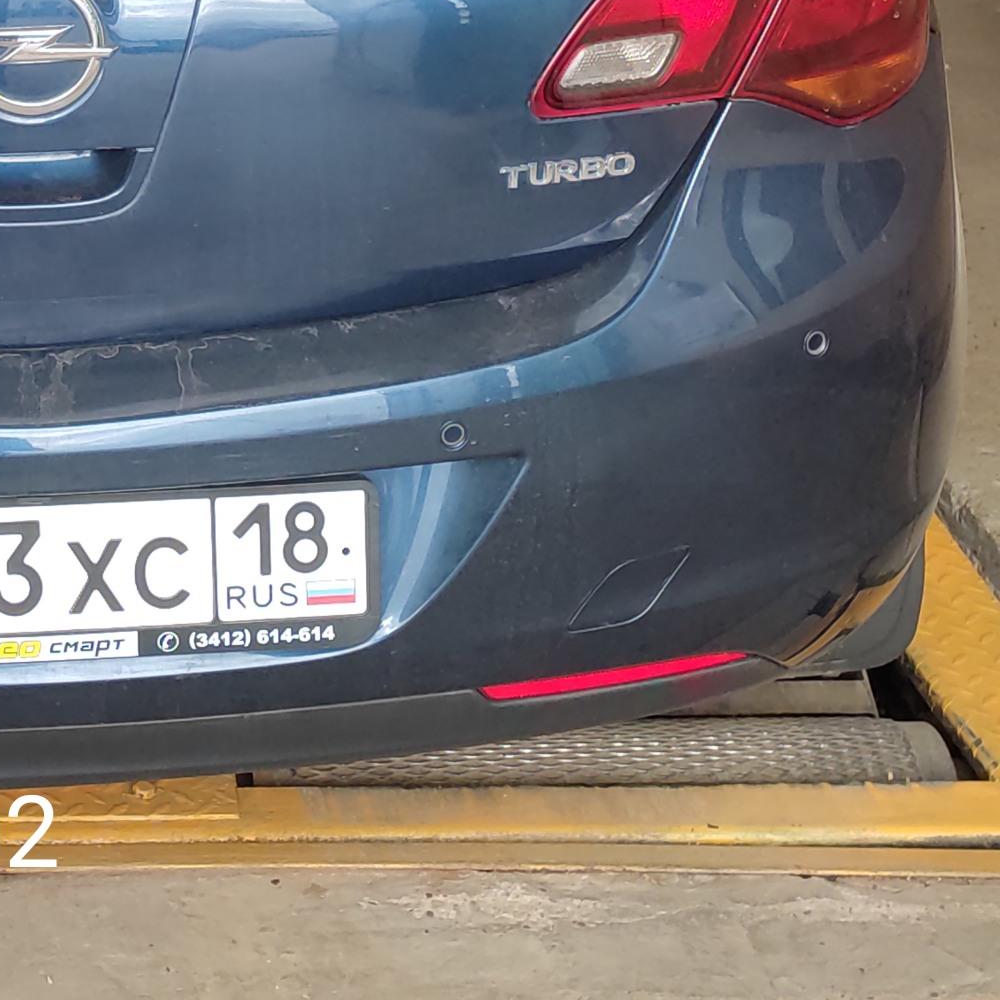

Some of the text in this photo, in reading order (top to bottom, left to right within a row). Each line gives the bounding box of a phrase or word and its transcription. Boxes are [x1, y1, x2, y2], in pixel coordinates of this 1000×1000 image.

[499, 151, 636, 190] TURBO
[232, 500, 329, 577] 18
[226, 582, 299, 610] RUS
[188, 628, 251, 650] (3412)
[255, 625, 336, 645] 614-614
